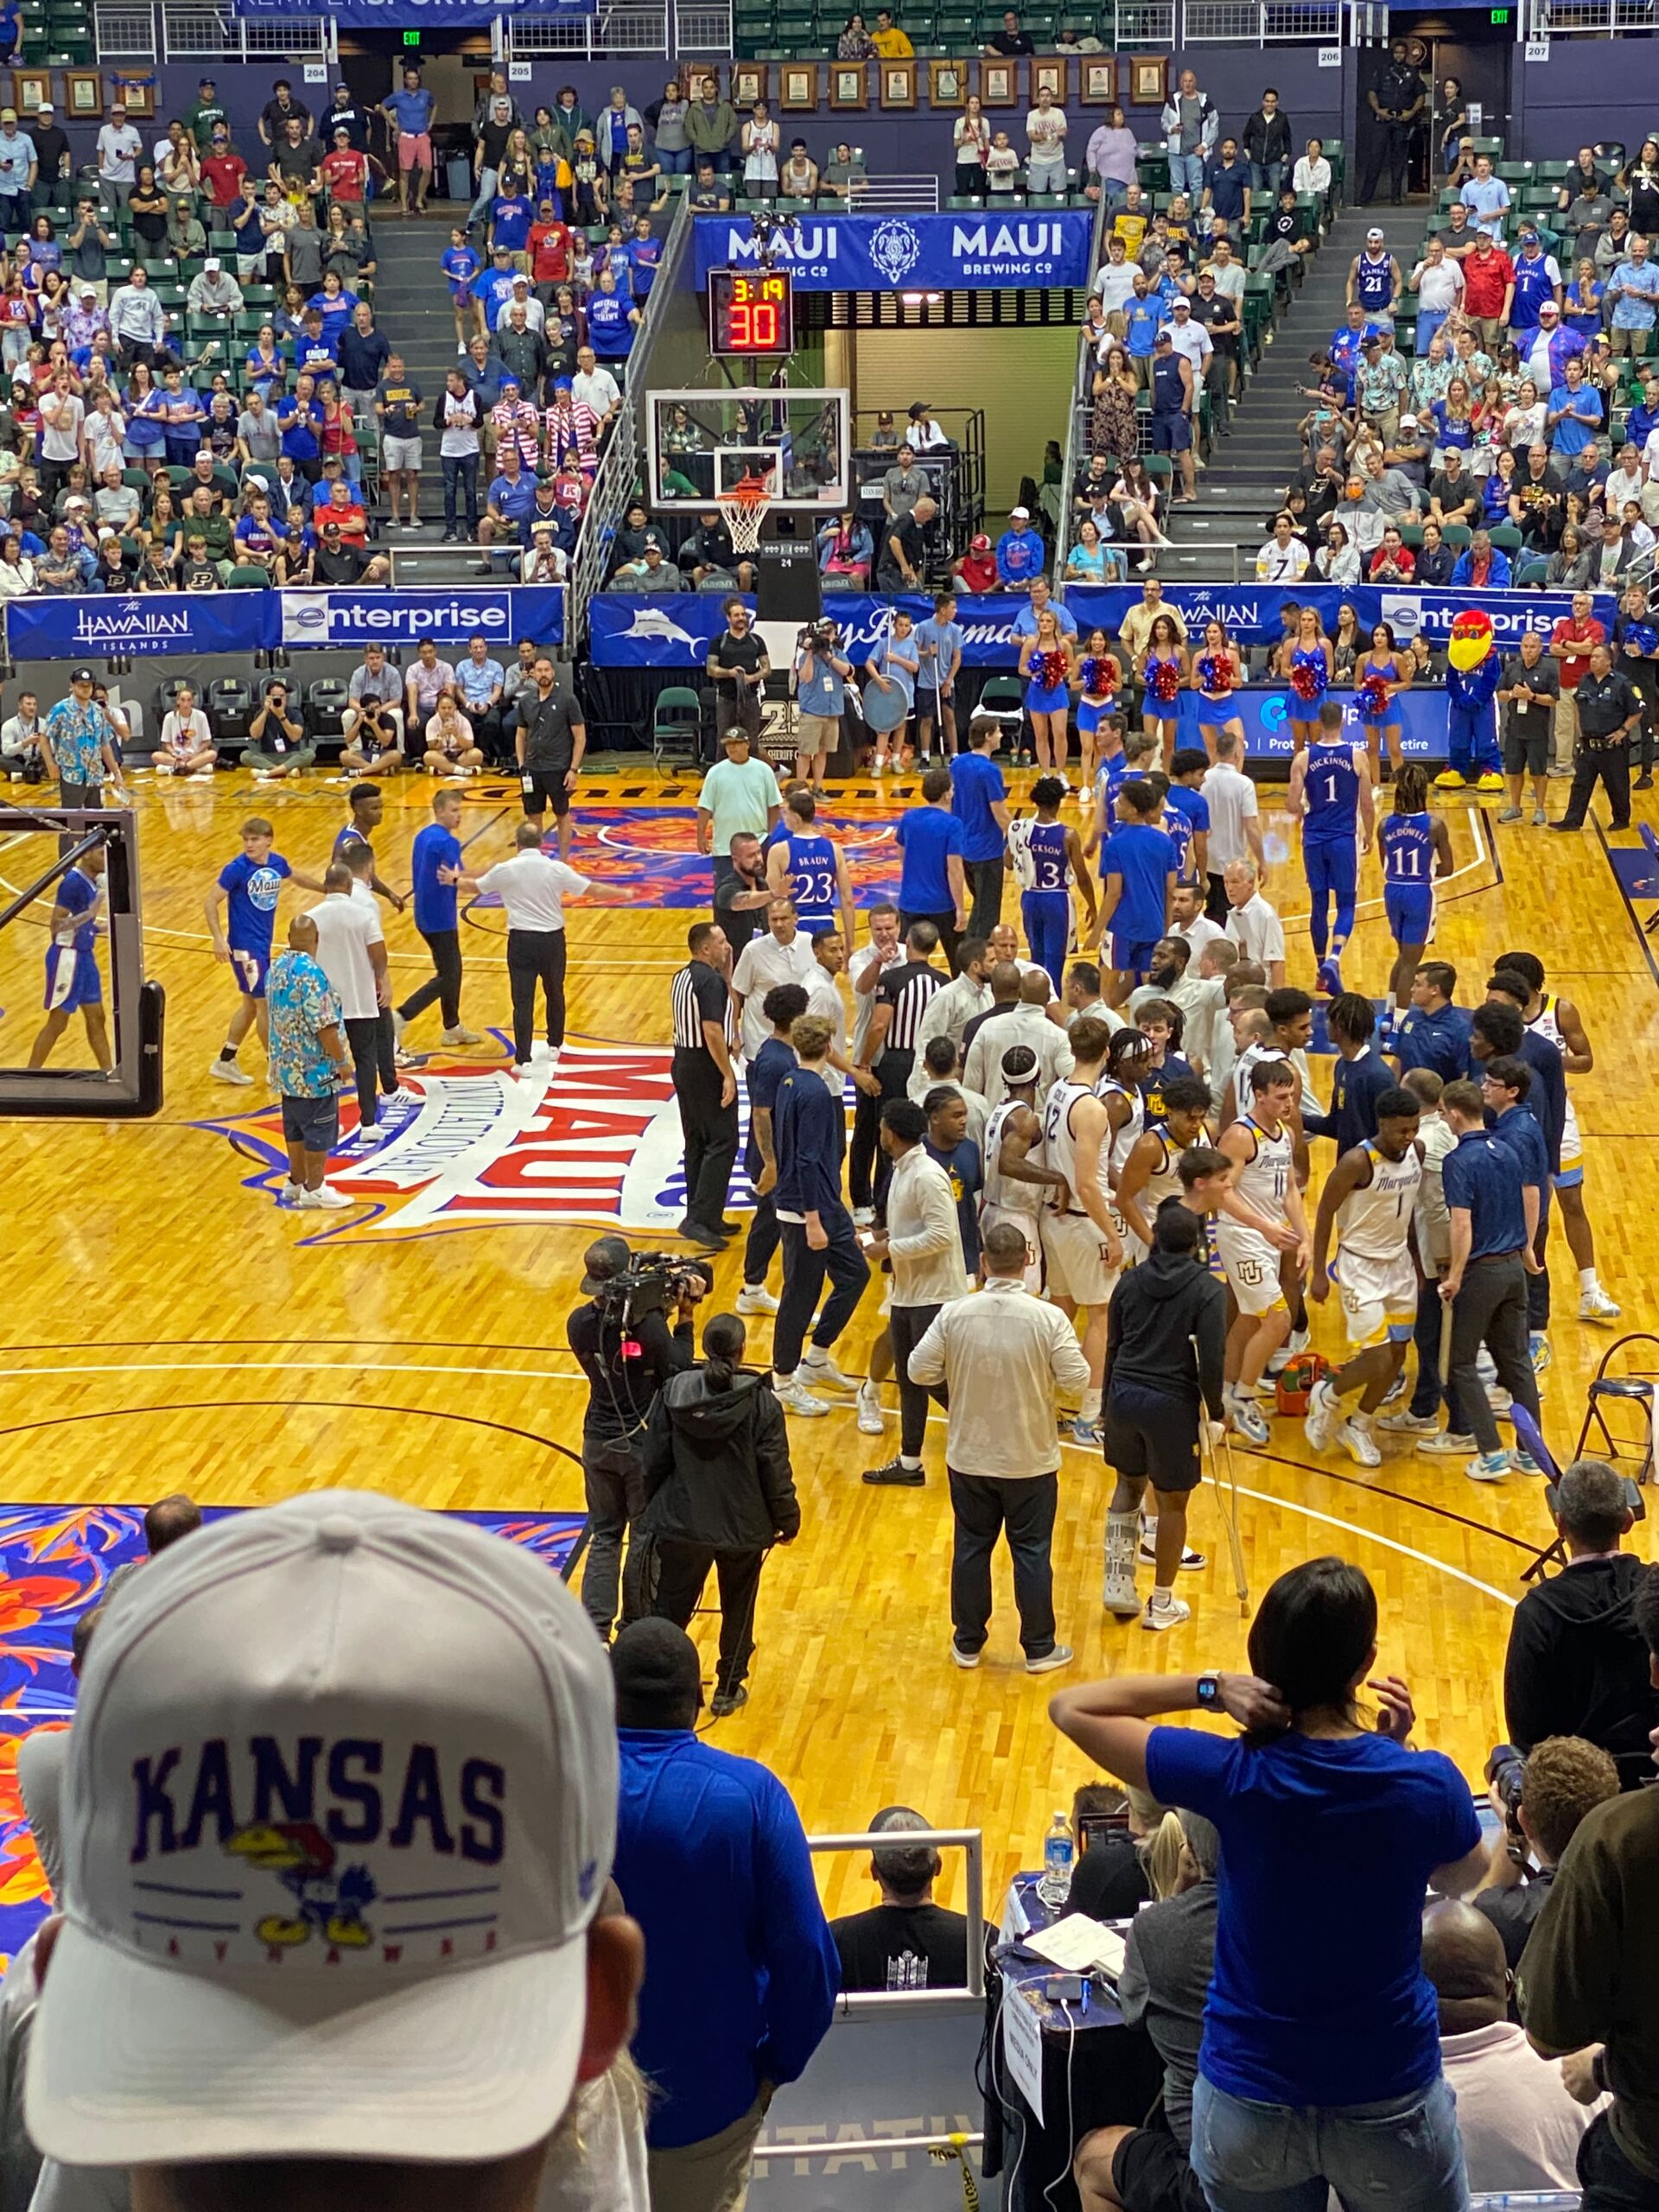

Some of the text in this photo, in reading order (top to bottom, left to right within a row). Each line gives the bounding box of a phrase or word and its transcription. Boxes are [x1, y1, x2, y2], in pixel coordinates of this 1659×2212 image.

[1491, 10, 1508, 24] EXIT
[404, 31, 420, 46] EXIT
[1320, 53, 1339, 61] 206
[1528, 48, 1547, 56] 207
[512, 67, 529, 77] 205
[952, 223, 1062, 257] MAUI
[963, 264, 1031, 275] BREWING
[734, 278, 784, 302] 3:19
[1364, 276, 1382, 293] 21
[1522, 276, 1529, 292] 1
[729, 304, 776, 346] 30
[781, 559, 791, 568] 24
[1268, 558, 1289, 582] 7
[191, 571, 214, 588] P
[283, 601, 506, 633] enterprise
[1177, 602, 1258, 625] WAIIAN
[1383, 607, 1570, 634] entprise
[78, 609, 188, 645] HAWAIIAN
[103, 640, 168, 651] ISLANDS
[768, 749, 793, 760] SHERIFF
[1401, 739, 1429, 750] etire
[1309, 756, 1353, 772] DICKINSON
[1324, 774, 1338, 803] 1
[1032, 843, 1062, 856] CKSON
[798, 856, 829, 868] BRAUN
[1392, 847, 1422, 877] 11
[795, 873, 832, 905] 23
[357, 1079, 505, 1176] INVITATIONAL
[430, 1052, 676, 1216] MAUI
[1274, 1173, 1283, 1198] 11
[1396, 1192, 1402, 1218] 1
[1236, 1260, 1262, 1285] MU
[130, 1735, 506, 1866] KANSAS
[1009, 2031, 1025, 2061] MEDIA
[1024, 2052, 1038, 2081] ONLY
